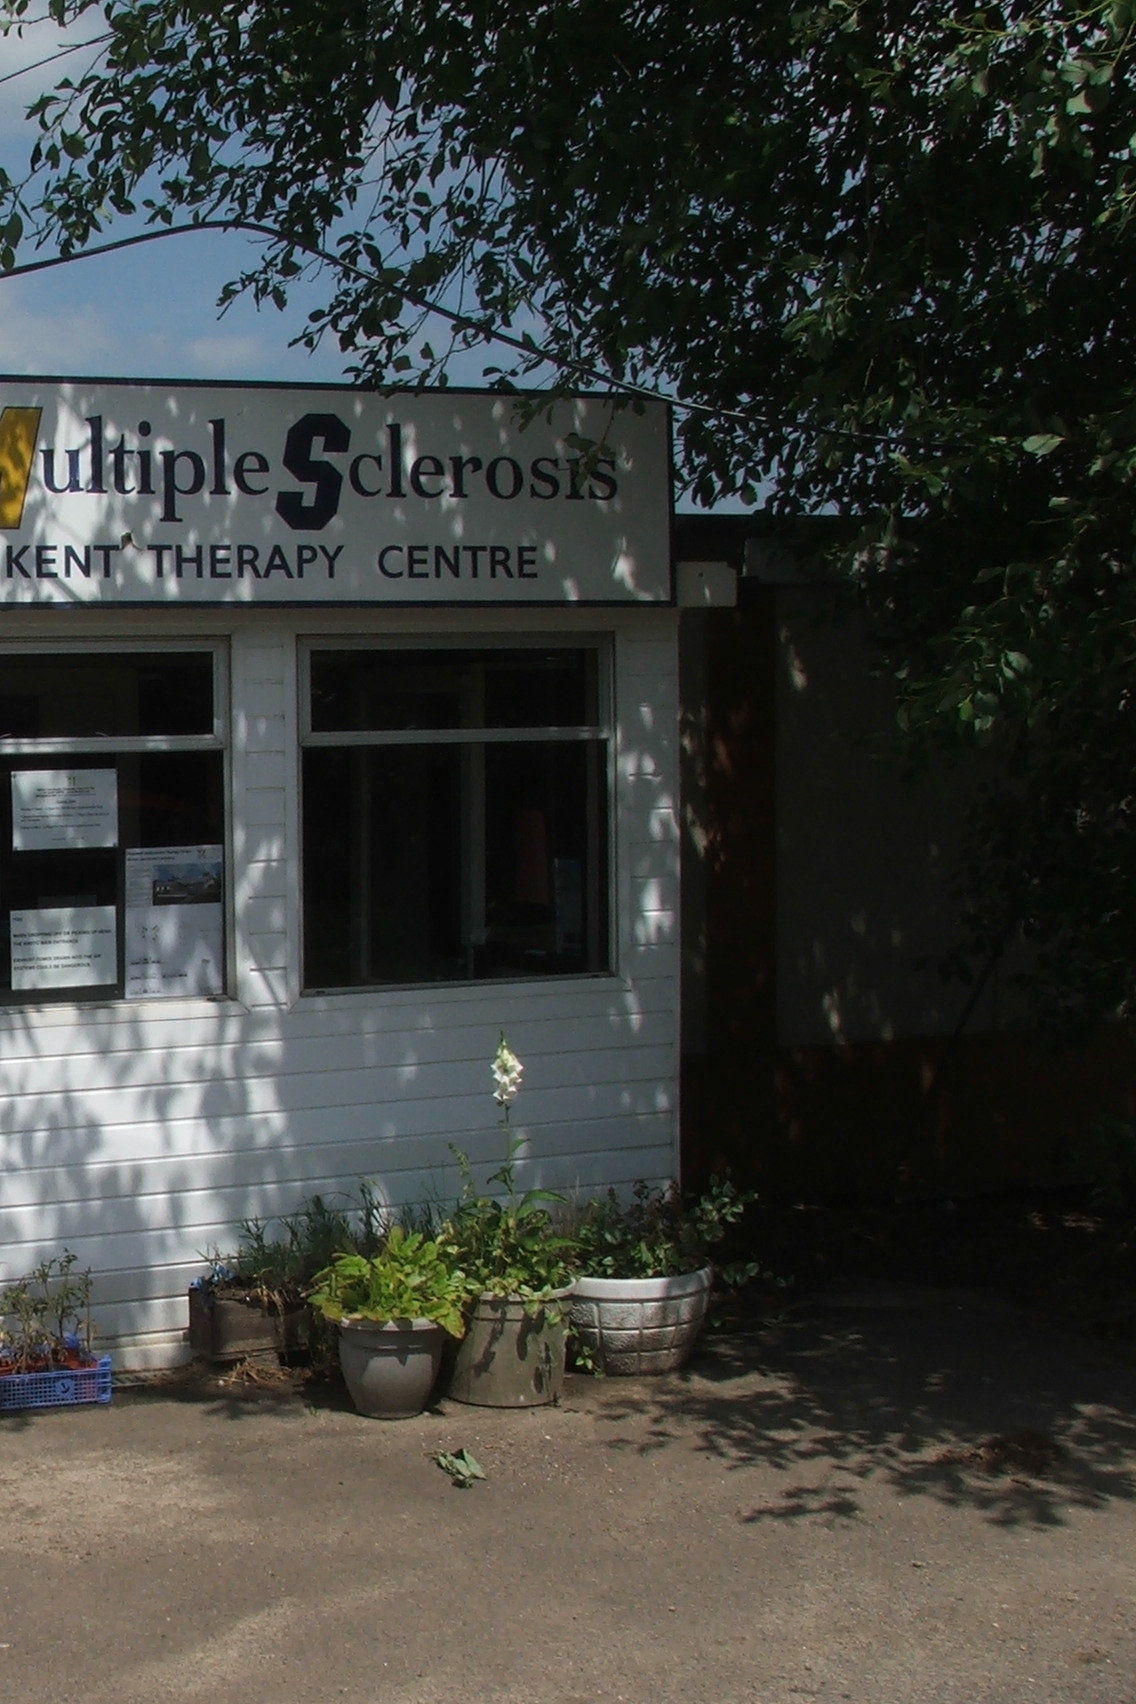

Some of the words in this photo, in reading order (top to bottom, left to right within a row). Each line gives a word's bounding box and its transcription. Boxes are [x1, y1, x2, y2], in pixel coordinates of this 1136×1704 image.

[275, 413, 619, 530] Sclerosis
[6, 544, 122, 579] KENT
[147, 545, 344, 580] THERAPY
[378, 545, 538, 579] CENTRE
